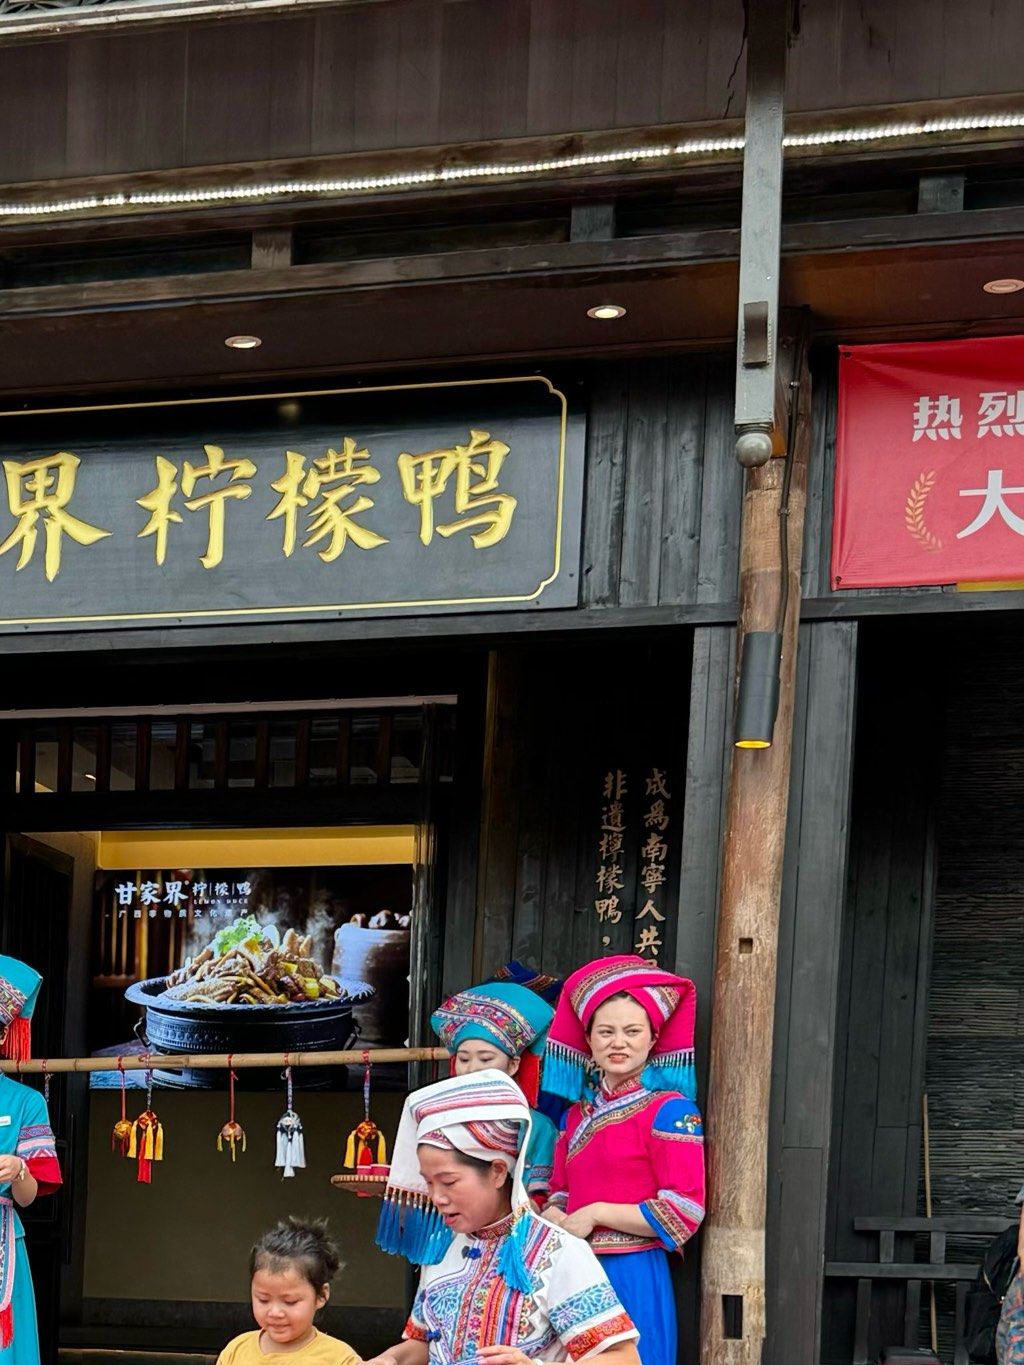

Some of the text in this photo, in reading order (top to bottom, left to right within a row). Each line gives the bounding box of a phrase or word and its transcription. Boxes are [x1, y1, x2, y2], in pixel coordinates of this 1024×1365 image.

[912, 390, 1024, 442] 热烈
[956, 469, 1024, 539] 大
[115, 881, 189, 906] 甘家界
[634, 767, 671, 967] 成爲南寧人共
